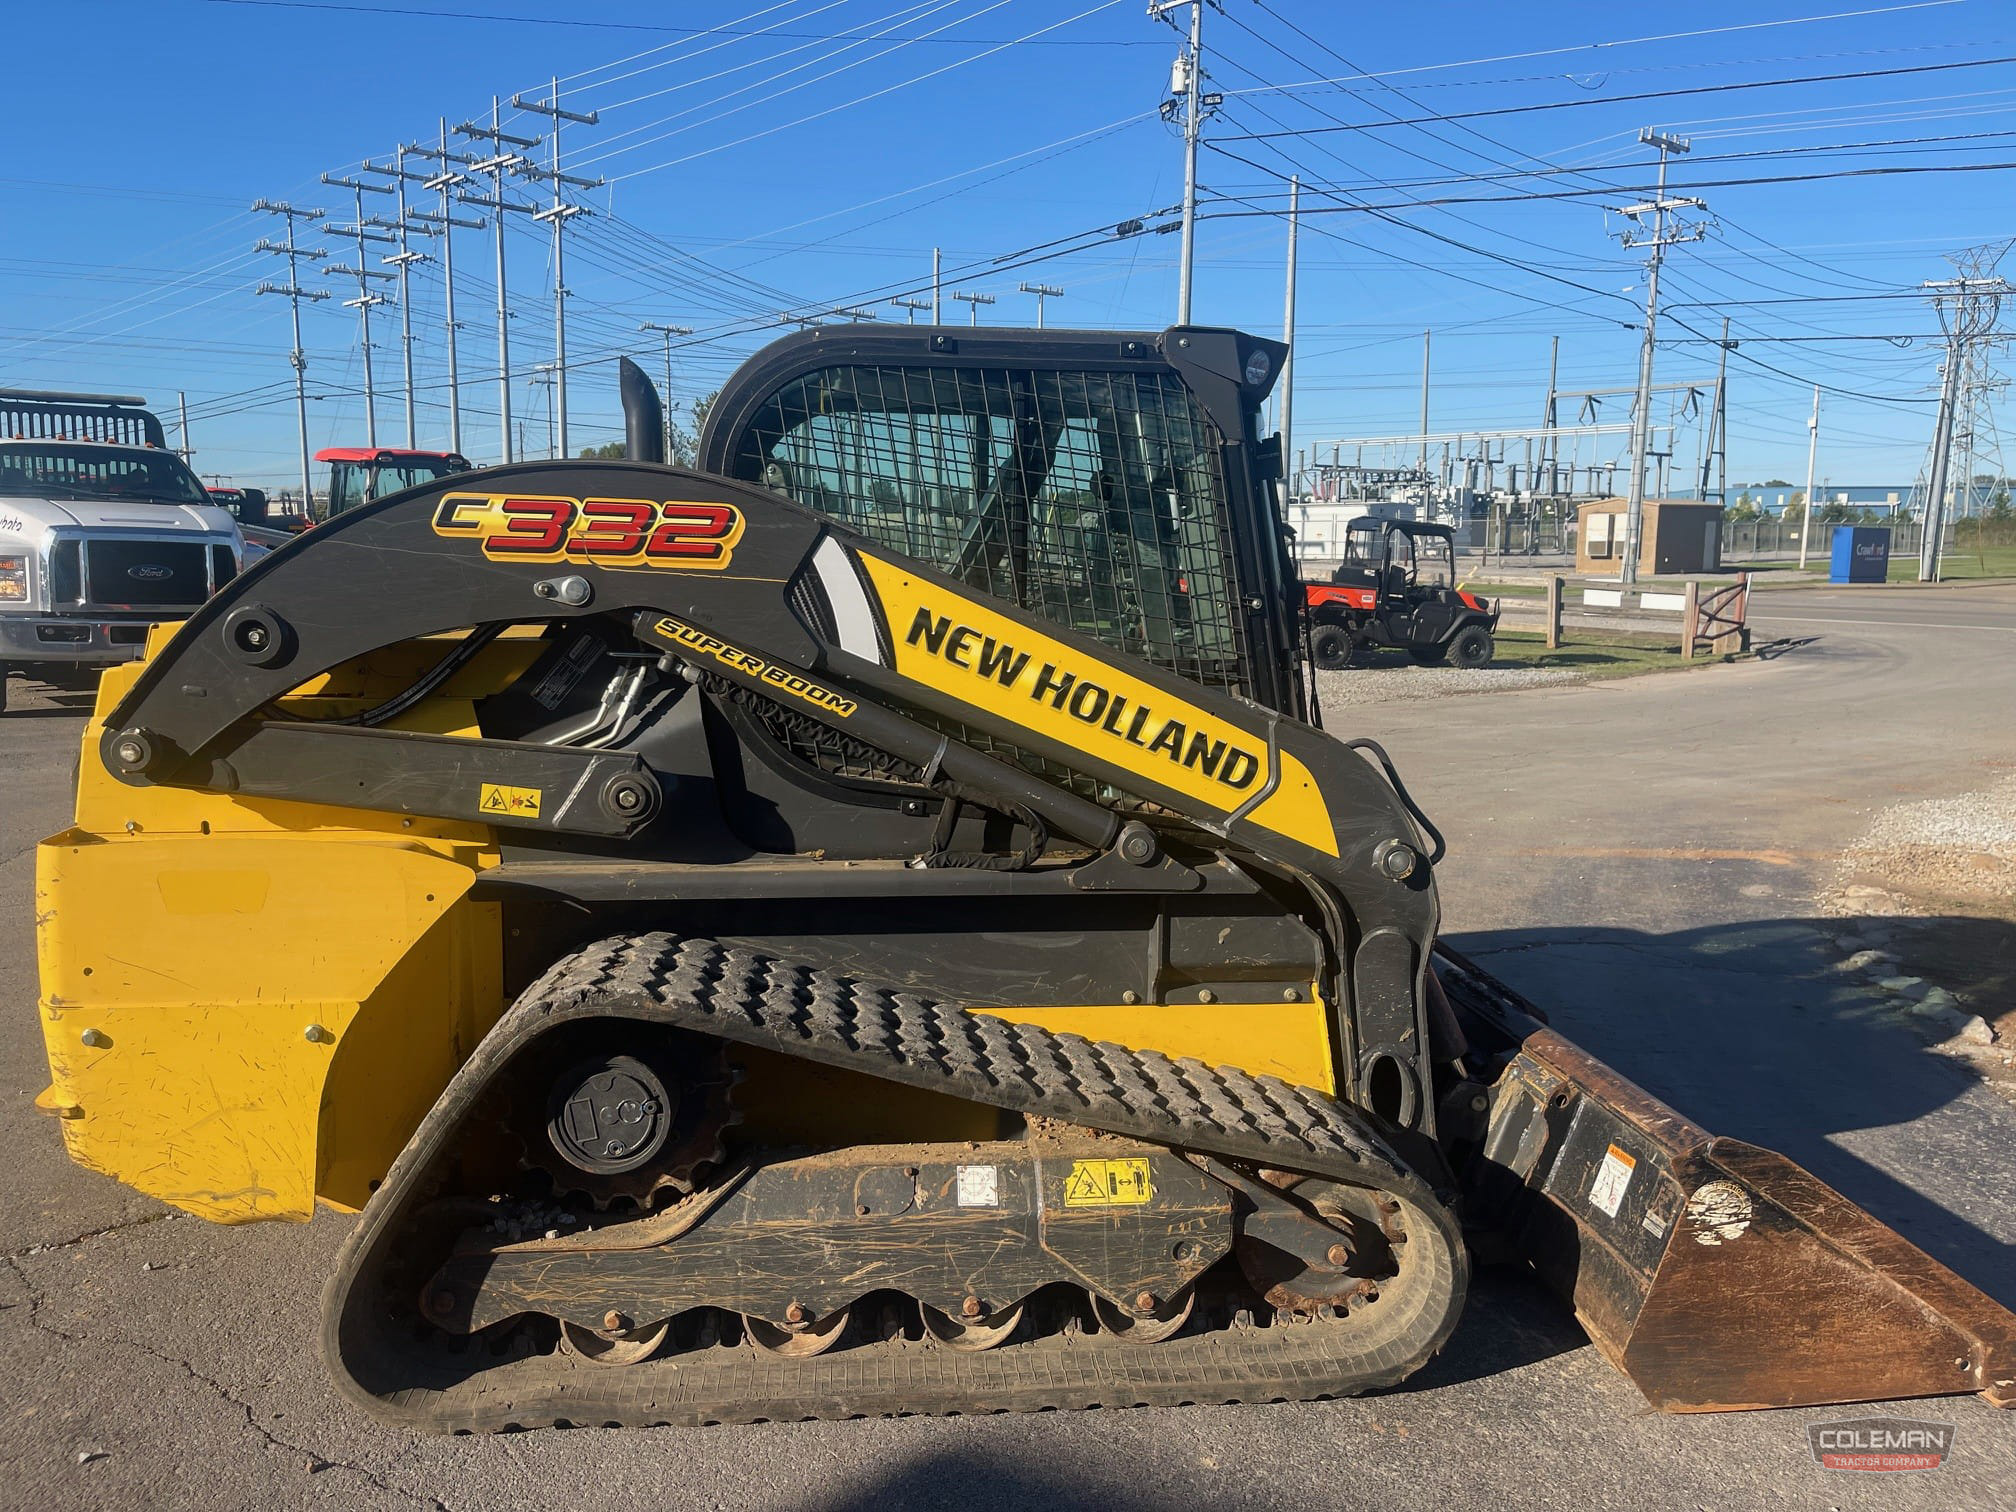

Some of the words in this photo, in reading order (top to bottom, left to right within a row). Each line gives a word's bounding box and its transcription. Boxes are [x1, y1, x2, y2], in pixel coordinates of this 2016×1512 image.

[139, 566, 164, 577] Ford
[433, 493, 745, 567] C332
[655, 618, 765, 676] SUPER
[761, 665, 858, 717] BOOM
[905, 605, 1031, 688] NEW
[1030, 662, 1260, 790] HOLLAND
